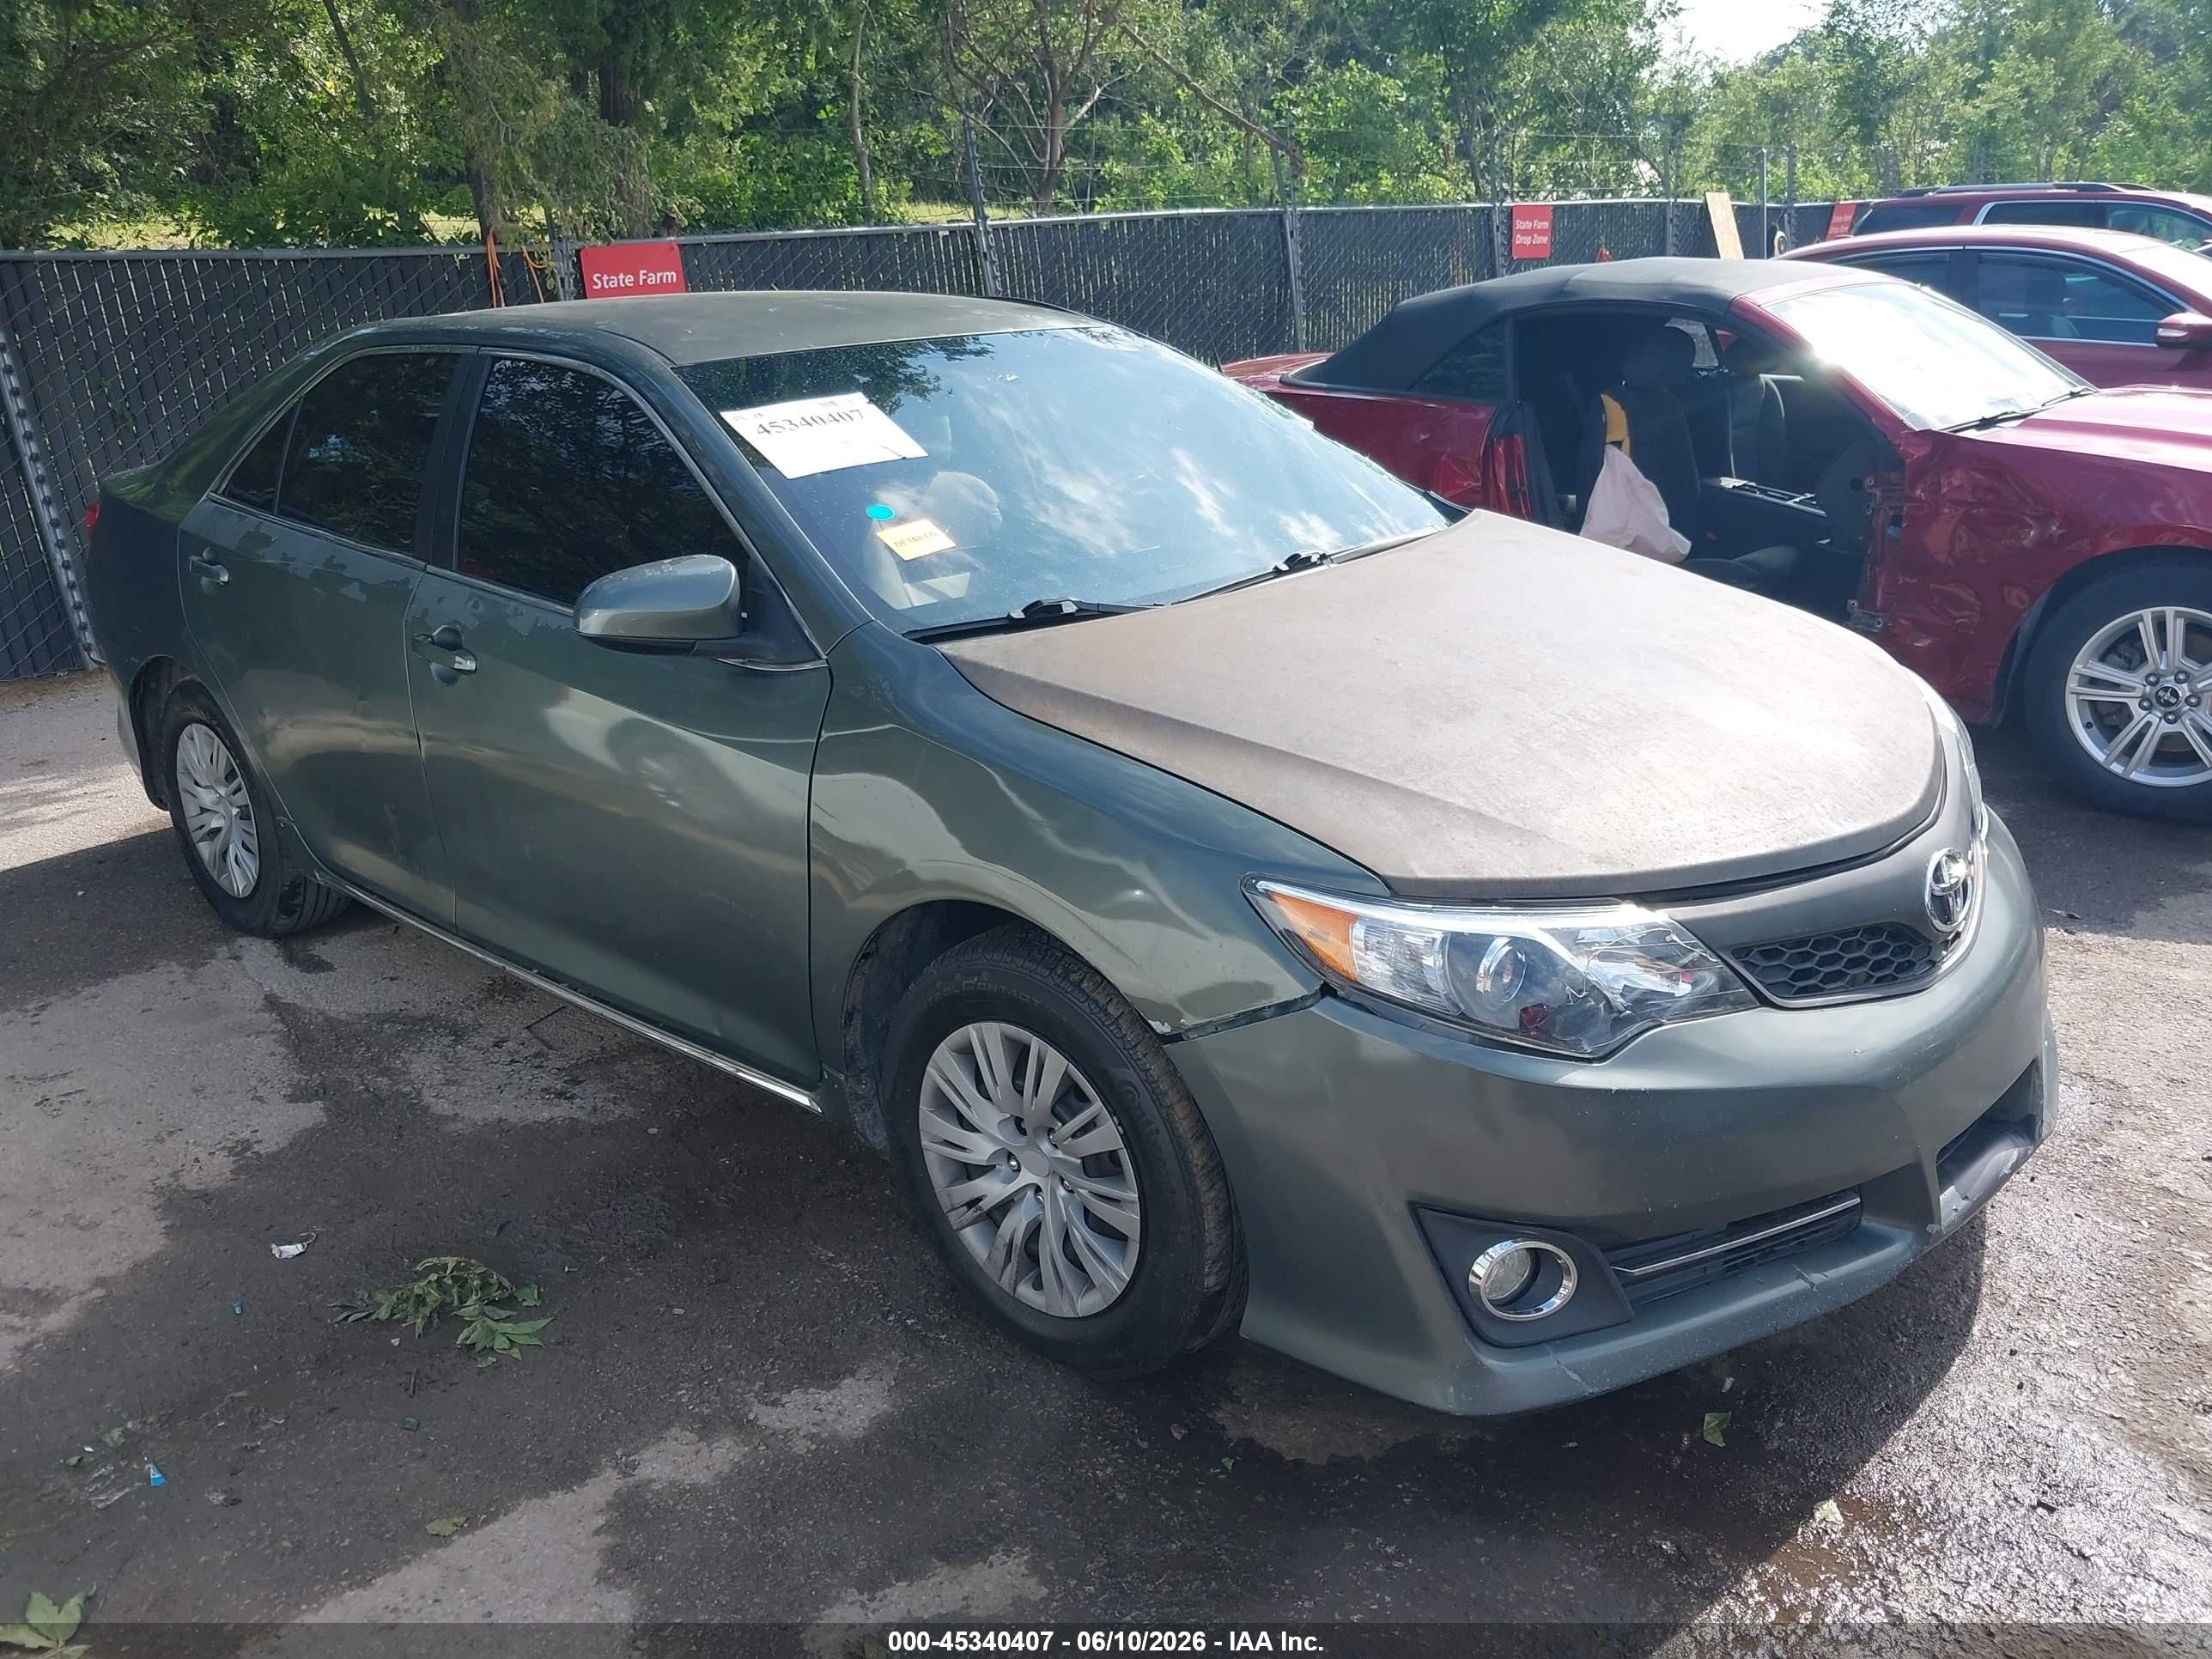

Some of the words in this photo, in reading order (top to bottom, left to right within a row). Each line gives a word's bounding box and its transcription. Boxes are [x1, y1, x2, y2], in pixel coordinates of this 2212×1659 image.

[1515, 219, 1533, 230] State
[1533, 219, 1549, 230] Farm
[1516, 234, 1532, 246] Drop
[1532, 234, 1548, 245] Zone
[592, 273, 635, 289] State
[639, 270, 678, 286] Farm
[757, 409, 865, 435] 45340407
